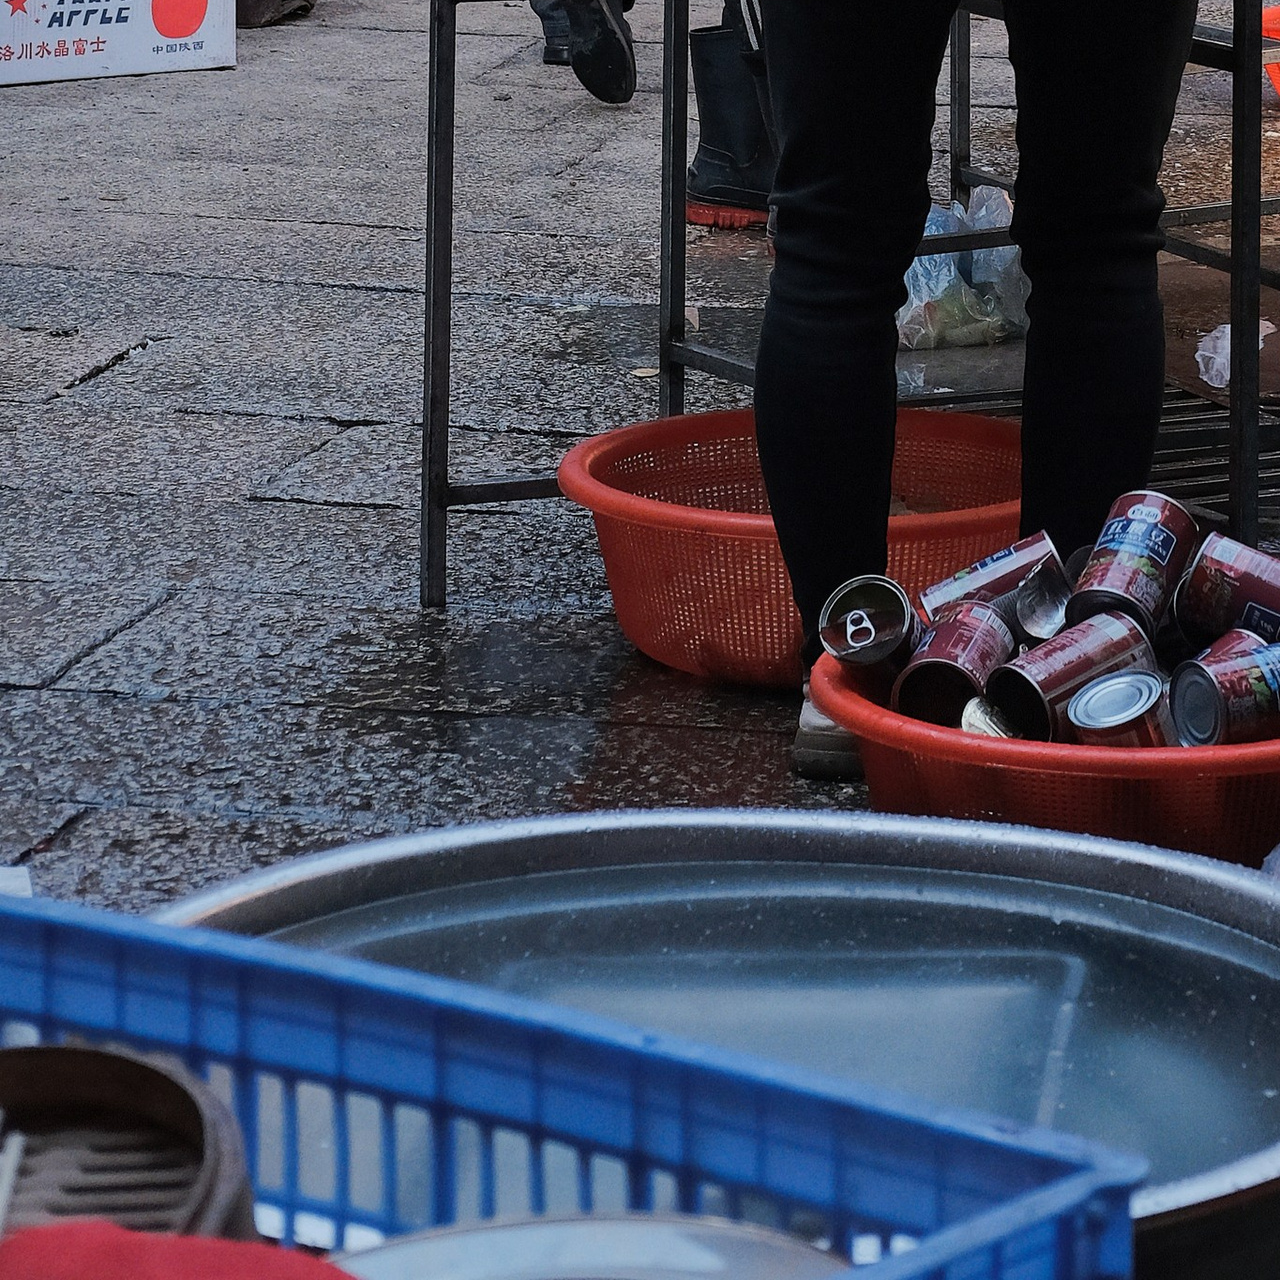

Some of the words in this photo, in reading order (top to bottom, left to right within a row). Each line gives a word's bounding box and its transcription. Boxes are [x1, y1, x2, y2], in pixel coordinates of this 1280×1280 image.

[0, 35, 107, 61] 洛川水晶富士
[152, 39, 205, 55] 中国陕西
